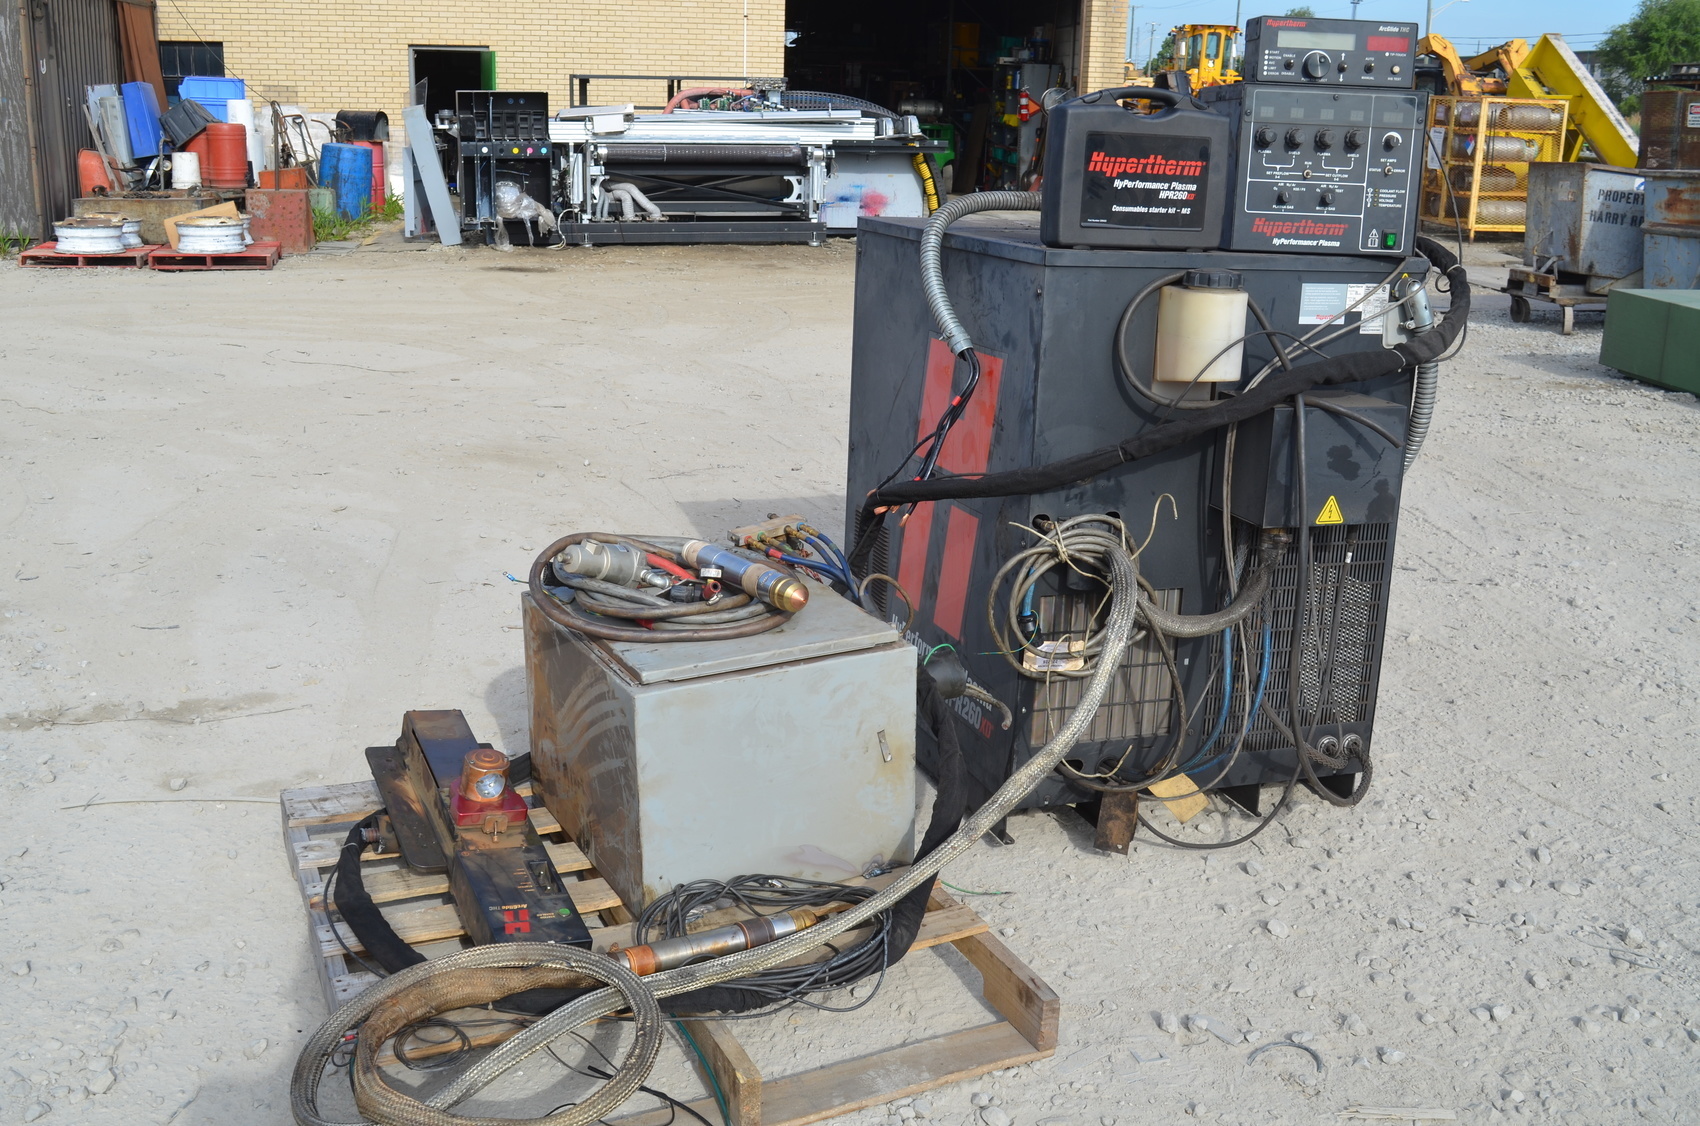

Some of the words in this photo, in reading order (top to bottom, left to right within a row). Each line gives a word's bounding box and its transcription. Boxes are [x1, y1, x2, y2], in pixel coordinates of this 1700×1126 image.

[1266, 18, 1307, 28] Hypertherm
[1088, 152, 1202, 177] Hypertherm
[1114, 179, 1168, 190] HyPerformance
[1170, 181, 1197, 191] Plasma
[1597, 189, 1644, 206] PROPERT
[1112, 204, 1148, 213] Consumables
[1589, 210, 1627, 226] HARRY
[1252, 218, 1345, 237] Hypertherm
[1272, 238, 1317, 246] HyPerformance
